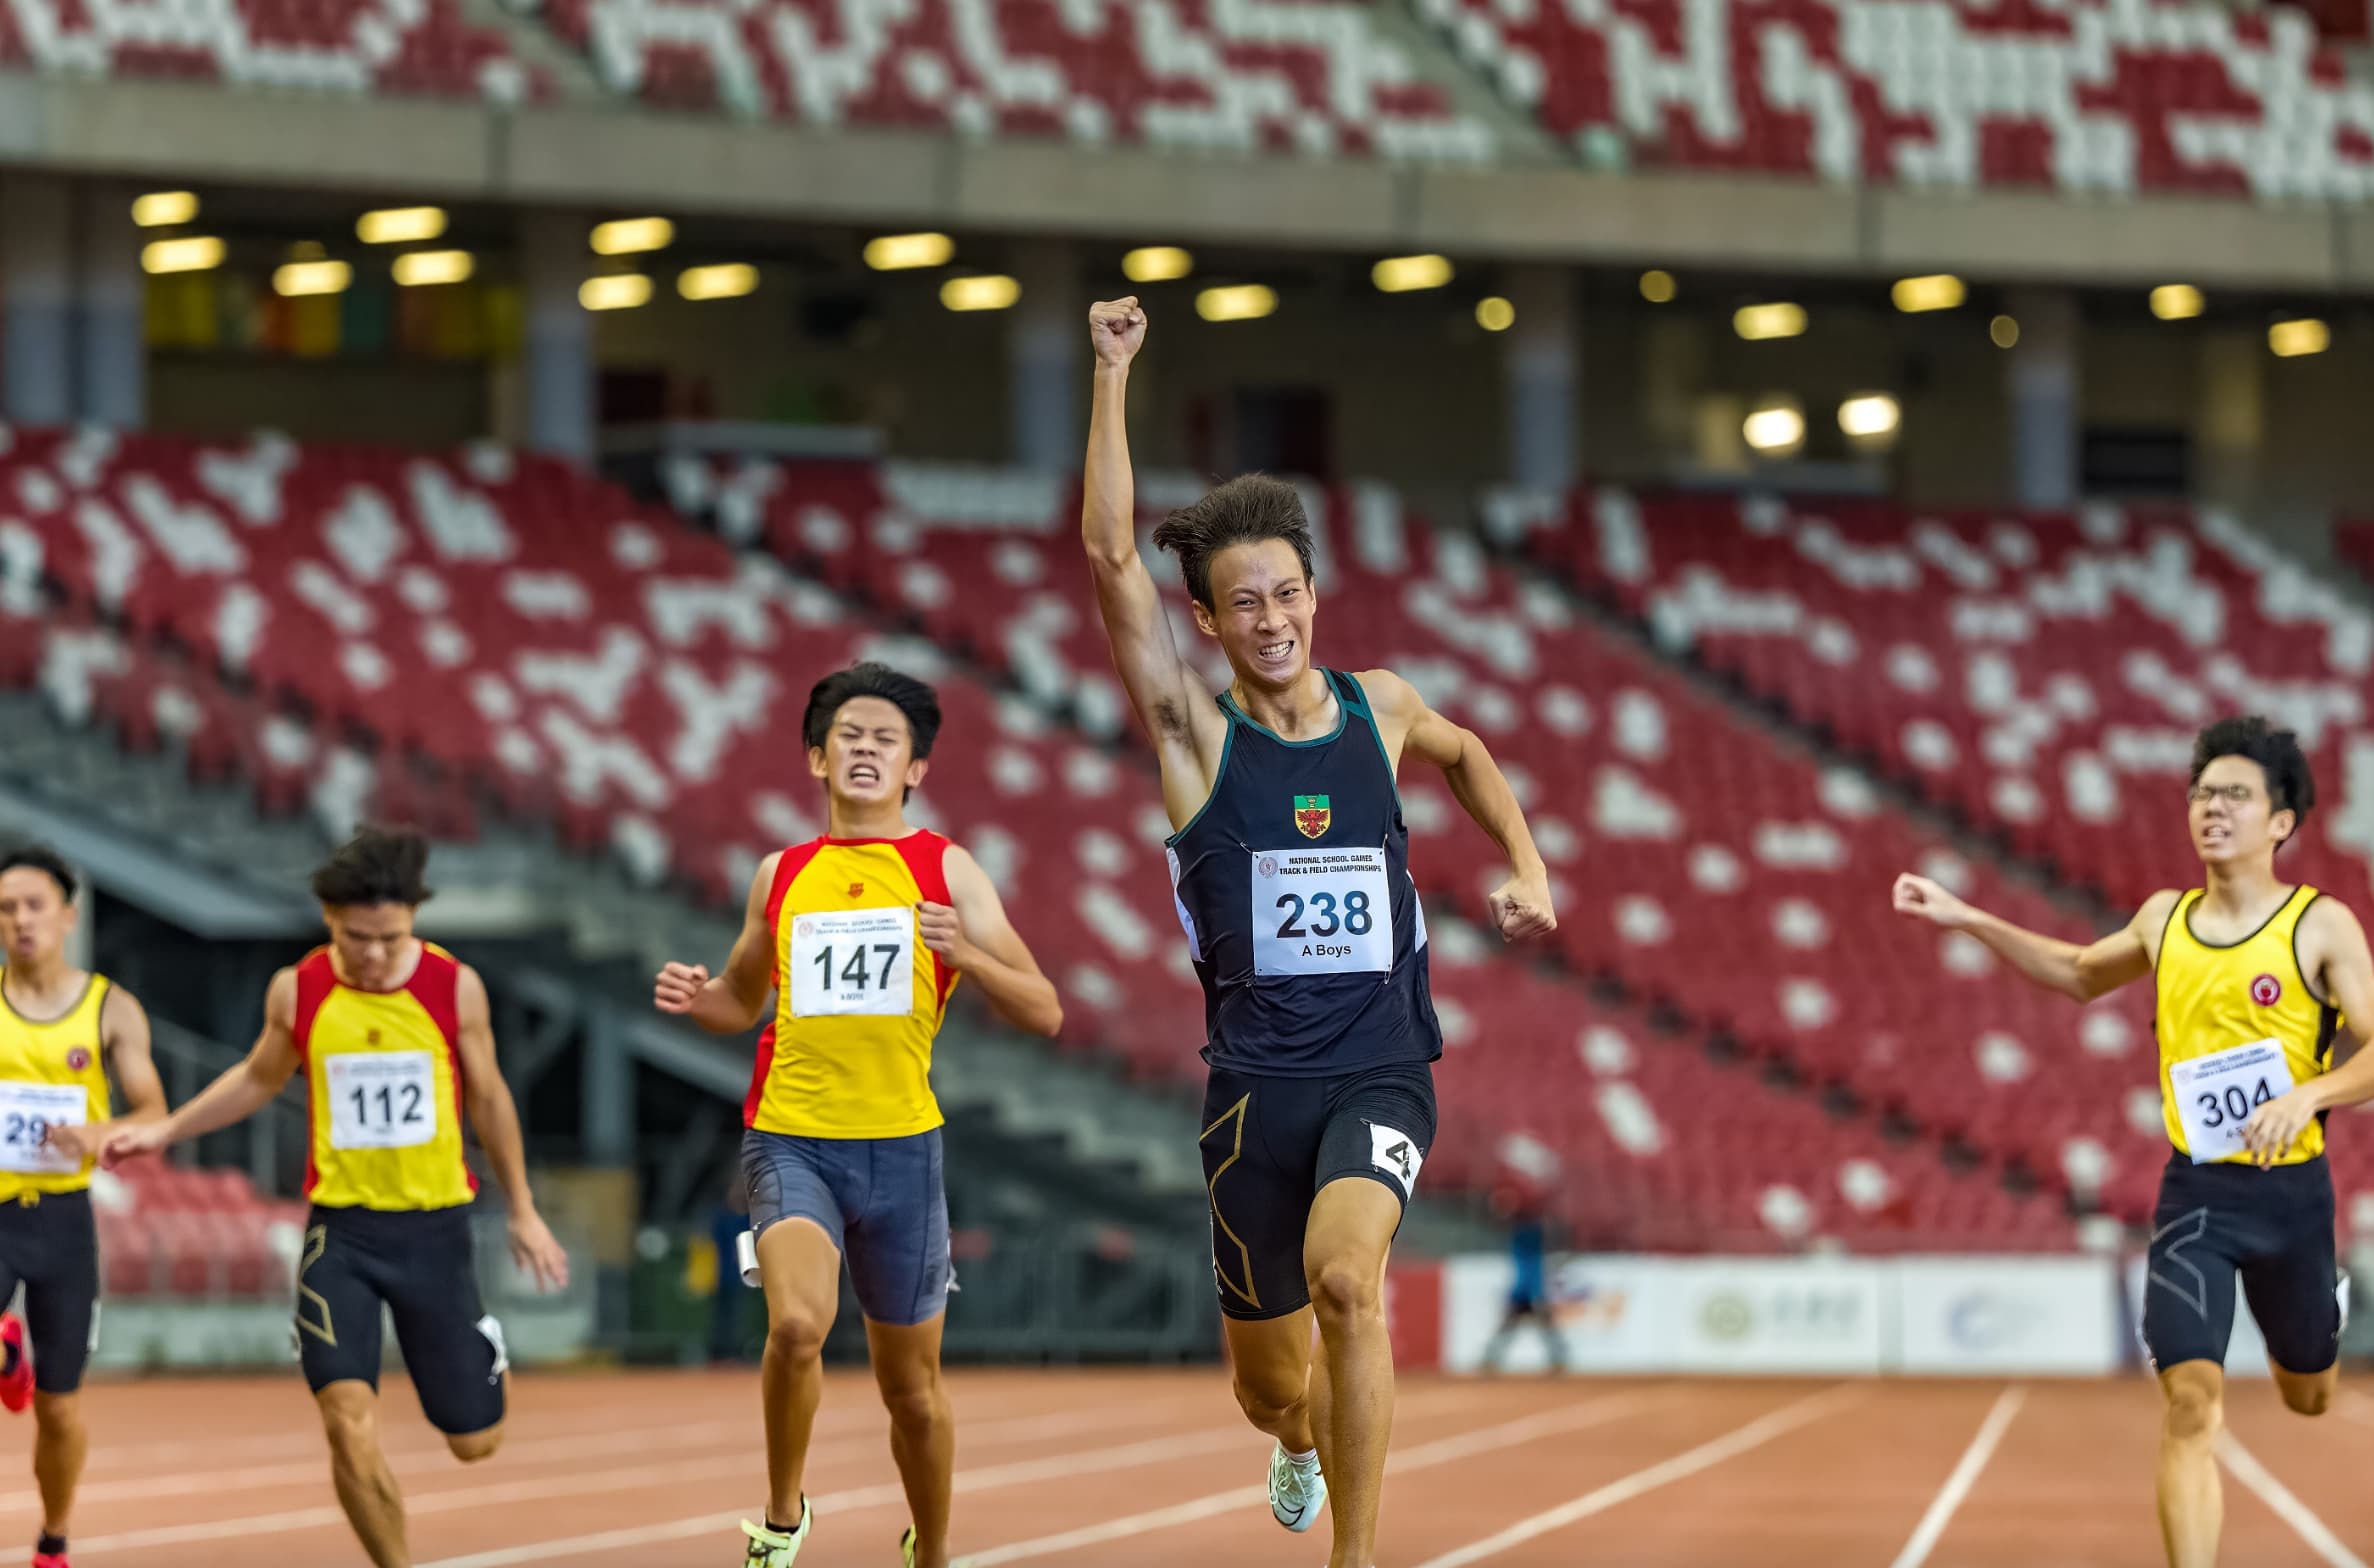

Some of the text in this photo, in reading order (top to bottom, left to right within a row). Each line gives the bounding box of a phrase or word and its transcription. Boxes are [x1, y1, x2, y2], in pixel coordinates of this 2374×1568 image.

[1280, 864, 1382, 875] TRACK & FIELD CHAMPIONSHIPS
[1289, 854, 1373, 865] NATIONAL SCHOOL GAMES
[1275, 890, 1373, 939] 238
[814, 944, 901, 991] 147
[1302, 944, 1352, 958] A Boys
[349, 1083, 424, 1126] 112
[2197, 1077, 2274, 1128] 304
[6, 1112, 67, 1146] 29
[1385, 1140, 1411, 1181] 4
